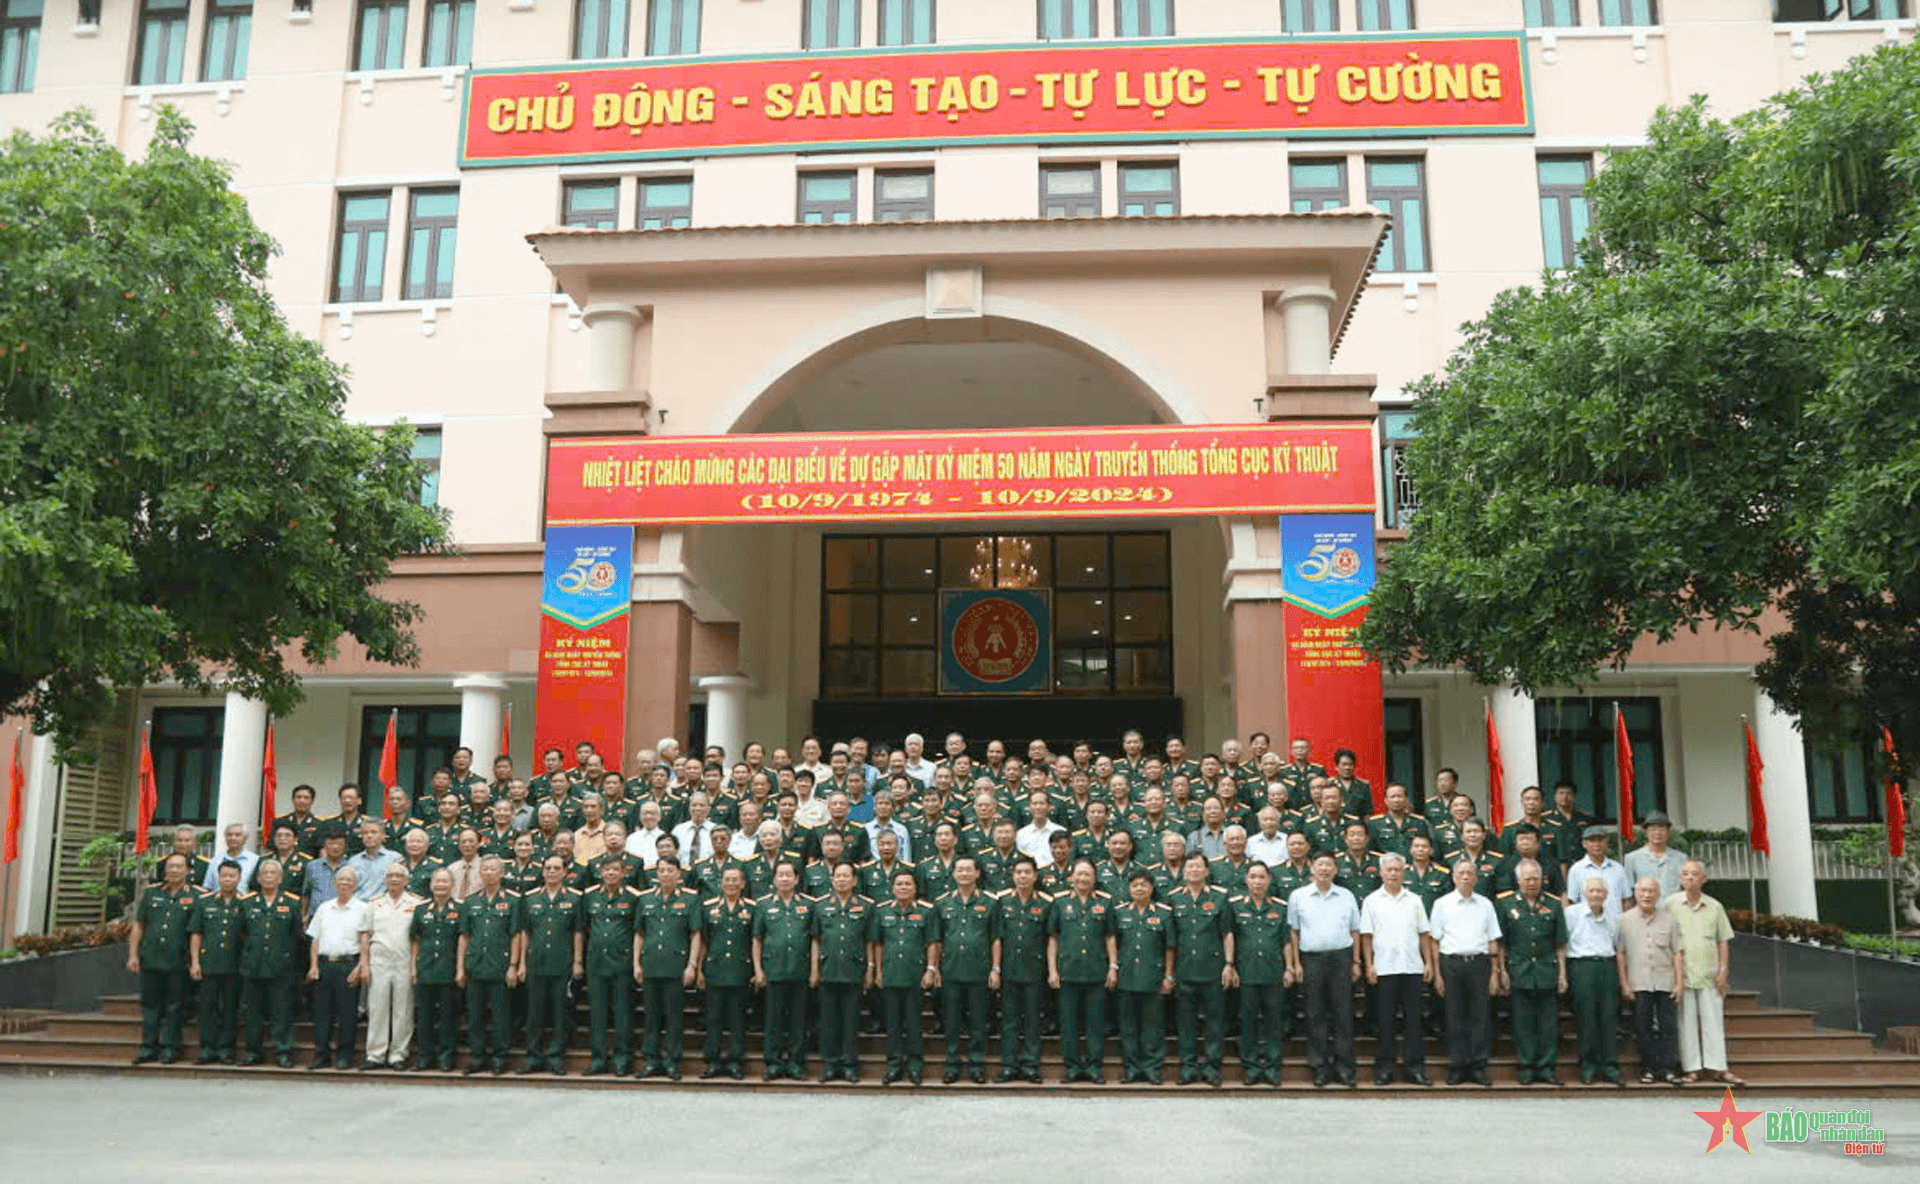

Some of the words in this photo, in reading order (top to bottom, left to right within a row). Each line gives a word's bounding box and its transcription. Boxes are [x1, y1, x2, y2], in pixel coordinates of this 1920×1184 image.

[488, 82, 573, 132] CHỦ
[592, 84, 715, 136] ĐỘNG
[764, 72, 894, 119] SÁNG
[910, 74, 998, 121] TẠO
[1036, 69, 1100, 119] TỰ
[1115, 66, 1207, 118] LỰC
[1257, 64, 1321, 114] TỰ
[1336, 52, 1503, 102] CƯỜNG
[583, 455, 622, 494] NHIỆT
[624, 454, 652, 493] LIỆT
[693, 452, 734, 486] MỪNG
[737, 451, 766, 485] CÁC
[767, 456, 792, 490] ĐẠI
[849, 453, 870, 489] DỰ
[871, 449, 900, 489] GẶP
[902, 449, 934, 488] MẶT
[957, 447, 995, 486] NIỆM
[997, 453, 1015, 480] 50
[1018, 446, 1052, 480] NĂM
[1151, 440, 1199, 476] THỐNG
[1241, 446, 1271, 480] CỤC
[1294, 440, 1340, 480] THUẬT
[739, 491, 934, 511] (10/9/1974
[977, 487, 1175, 506] 10/9/2024)
